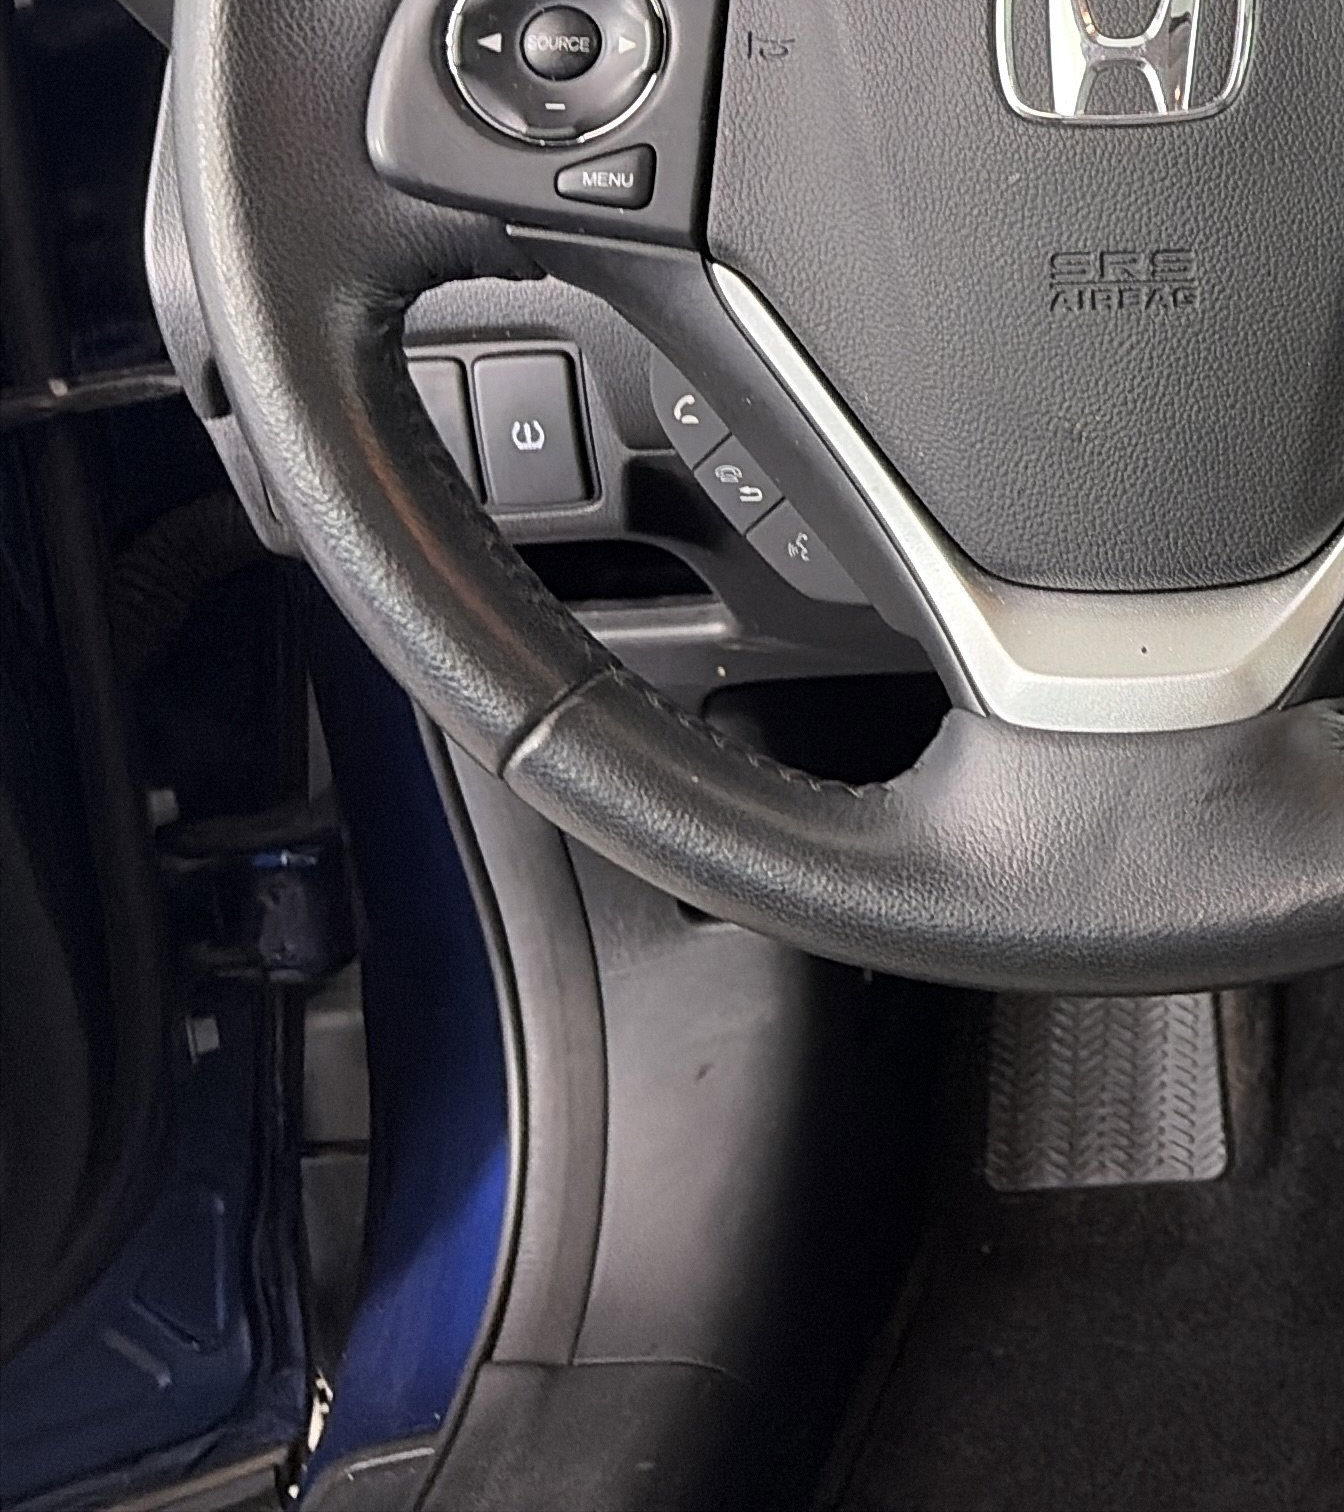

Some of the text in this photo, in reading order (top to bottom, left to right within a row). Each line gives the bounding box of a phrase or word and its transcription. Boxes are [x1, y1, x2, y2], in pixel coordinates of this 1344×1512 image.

[527, 34, 590, 54] SOURCE
[582, 170, 634, 189] MENU
[1050, 249, 1196, 281] SRS
[1050, 286, 1199, 313] AIRBAG
